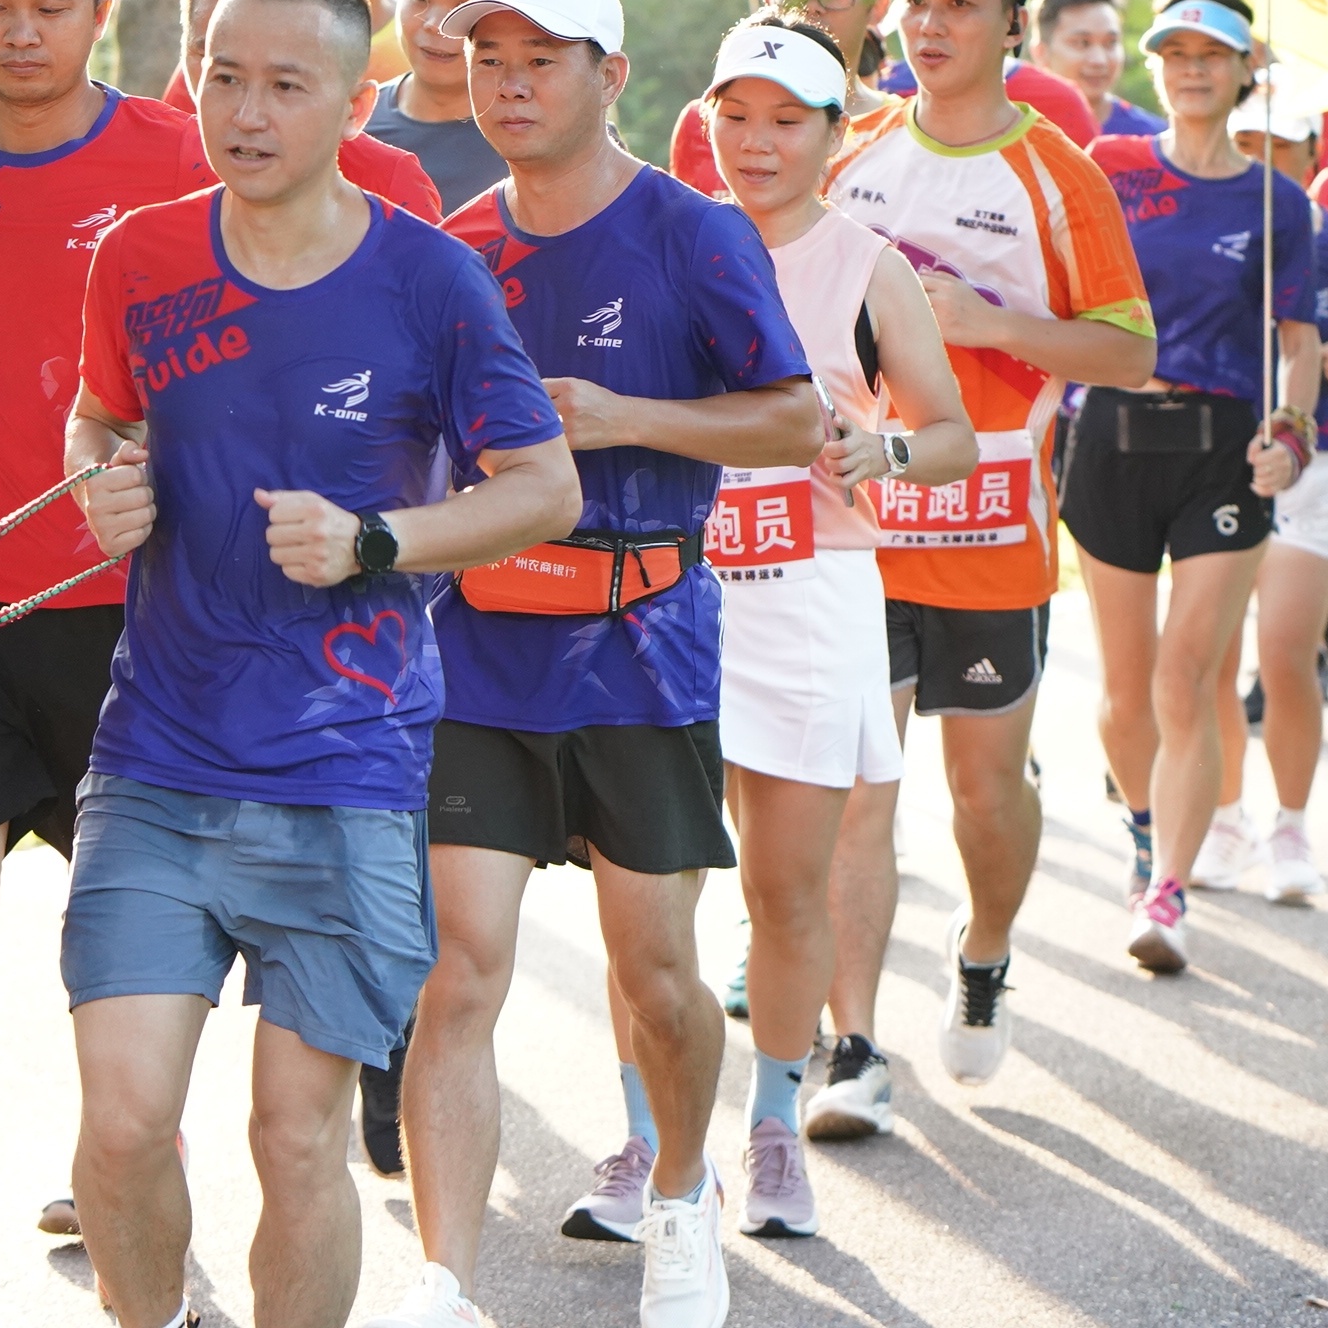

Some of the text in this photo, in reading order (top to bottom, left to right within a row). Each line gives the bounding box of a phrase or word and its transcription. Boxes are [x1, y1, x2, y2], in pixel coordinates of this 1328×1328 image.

[66, 237, 97, 249] K-o
[577, 334, 623, 349] K-one
[314, 403, 368, 422] K-one
[878, 471, 1013, 523] 陪跑员
